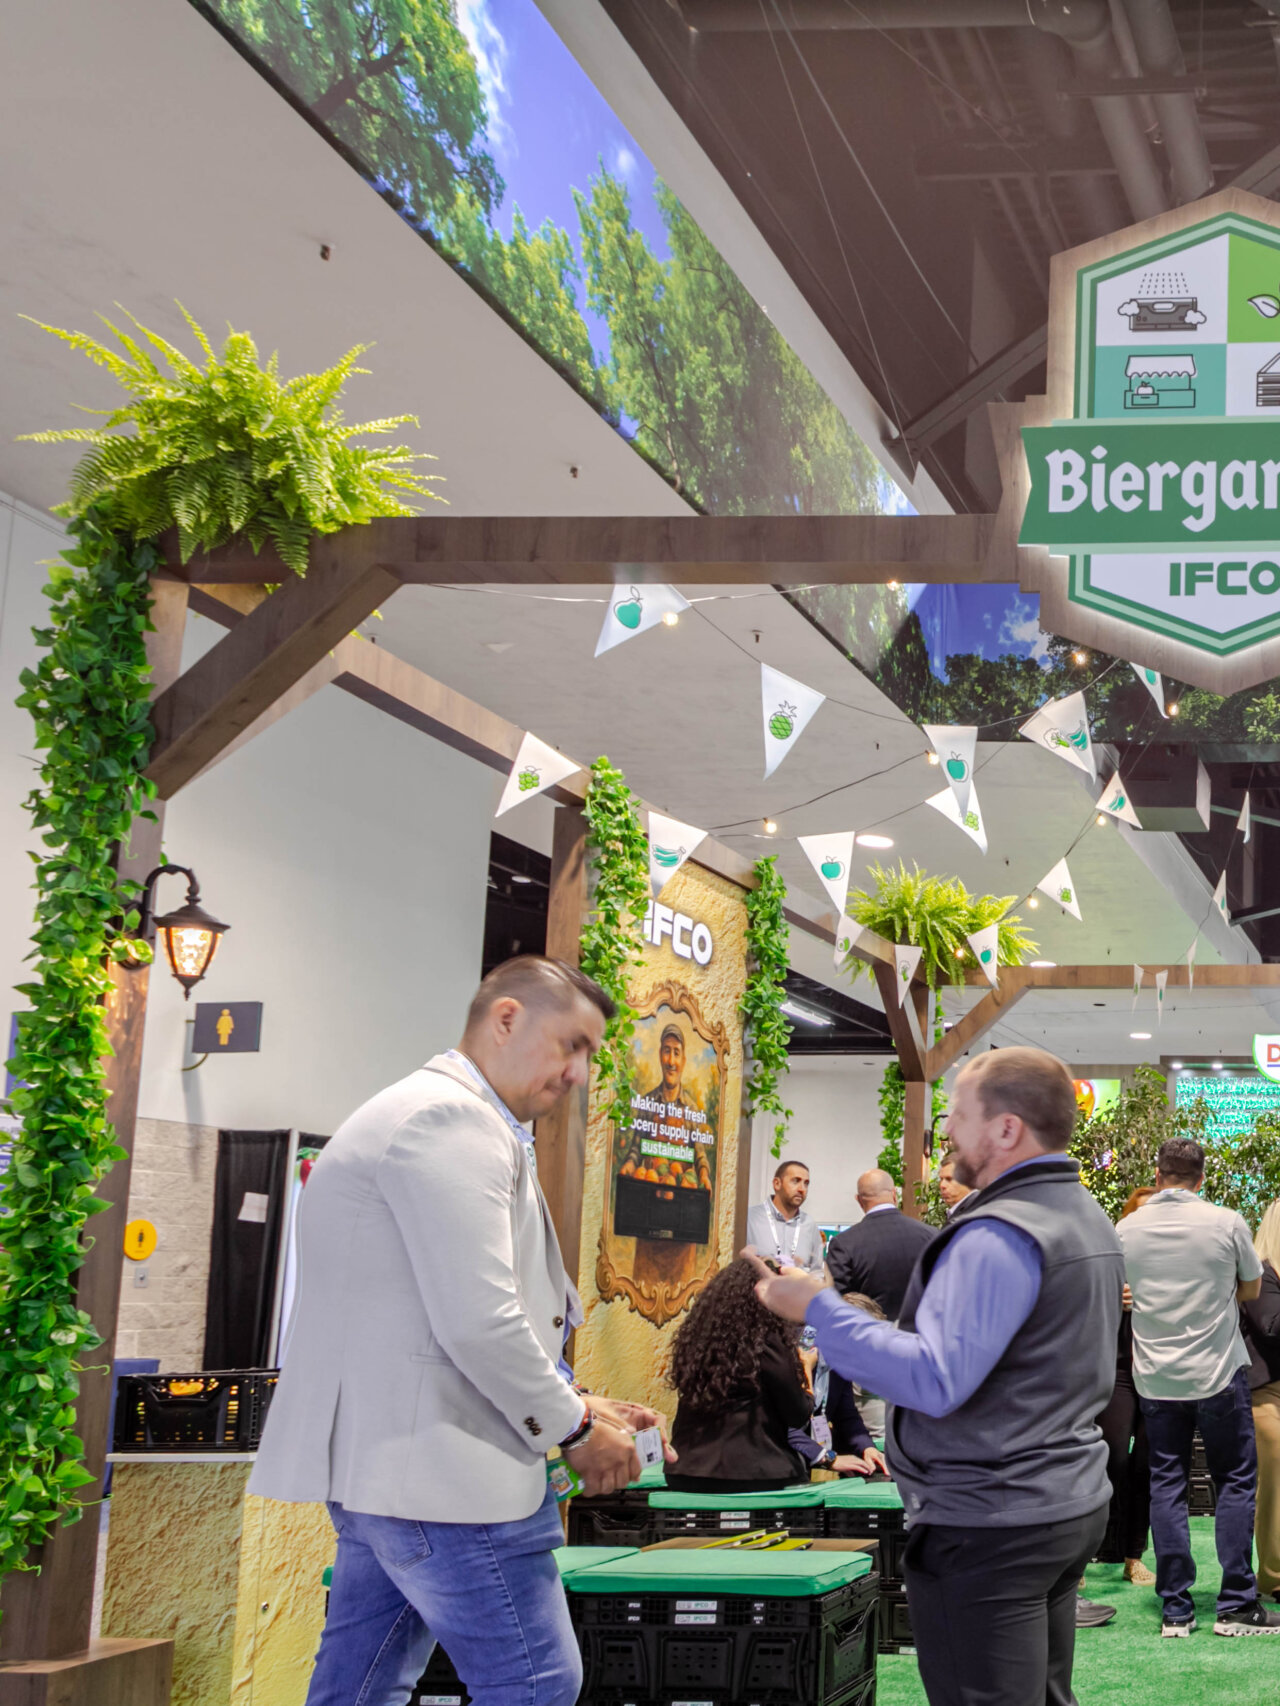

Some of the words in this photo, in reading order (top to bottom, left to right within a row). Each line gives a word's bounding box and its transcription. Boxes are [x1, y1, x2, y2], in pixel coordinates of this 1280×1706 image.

[643, 899, 713, 966] IFCO
[631, 1094, 666, 1118] Making
[667, 1102, 683, 1118] the
[684, 1106, 707, 1124] fresh
[619, 1115, 658, 1137] gocery
[659, 1123, 690, 1143] supply
[691, 1127, 714, 1145] chain
[641, 1139, 694, 1161] sustainable
